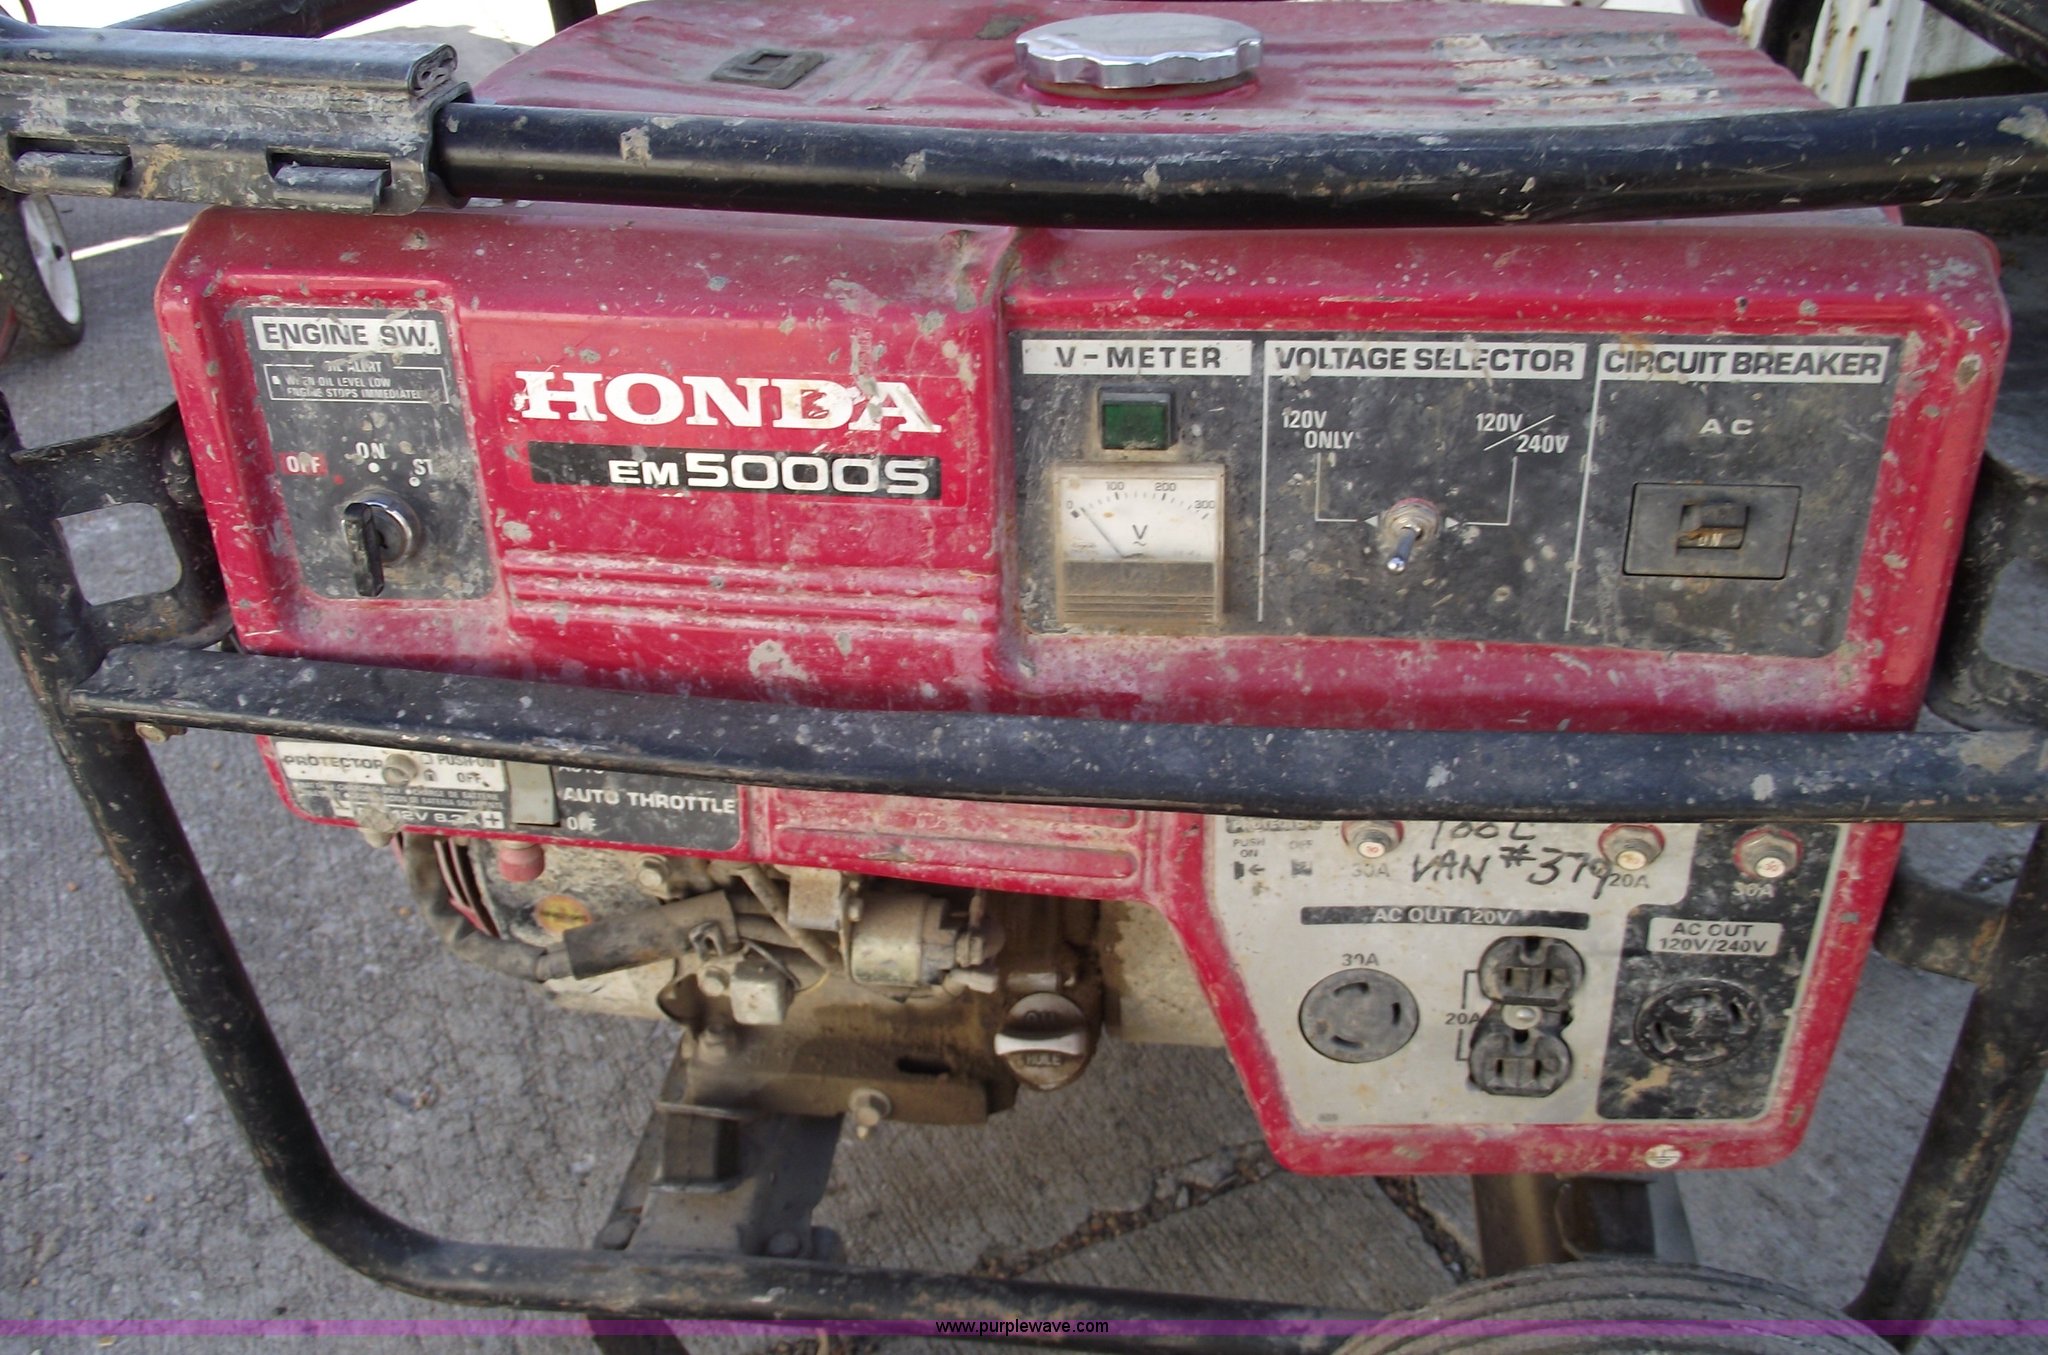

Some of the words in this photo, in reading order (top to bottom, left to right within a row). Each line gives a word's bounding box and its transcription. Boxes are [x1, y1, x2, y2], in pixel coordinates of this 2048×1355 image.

[262, 322, 369, 345] ENGINE
[380, 325, 435, 348] SW.
[1276, 347, 1406, 370] VOLTAGE
[1414, 348, 1575, 372] SELECTOR
[1604, 350, 1726, 374] CIRCUIT
[1731, 351, 1882, 376] BREAKER
[318, 377, 334, 387] OIL
[337, 378, 366, 387] LEVEL
[368, 378, 391, 388] LOW
[287, 387, 323, 398] ENGINE
[325, 388, 358, 398] STOPS
[513, 370, 942, 433] HONDA
[1282, 410, 1327, 429] 120V
[1304, 430, 1353, 449] ONLY
[355, 442, 386, 459] ON
[286, 454, 321, 473] OFF
[609, 452, 930, 495] EM5000S
[1105, 481, 1125, 492] 100
[1155, 482, 1177, 493] 200
[1066, 500, 1074, 510] 0
[1194, 500, 1216, 510] 300
[1132, 524, 1148, 541] V
[283, 755, 383, 770] PROTECTOR
[563, 787, 620, 805] AUTO
[627, 791, 736, 814] THROTTLE
[566, 816, 597, 832] OFF
[1233, 838, 1266, 848] PUSH
[1240, 849, 1259, 858] ON
[1412, 849, 1490, 885] VAN
[1608, 872, 1650, 889] 20A
[1731, 881, 1775, 898] 30A
[1373, 908, 1402, 923] AC
[1409, 908, 1455, 924] OUT
[1462, 909, 1513, 925] 120V
[1672, 923, 1701, 936] AC
[1708, 924, 1754, 938] OUT
[1659, 938, 1768, 953] 120V/240V
[1445, 1012, 1481, 1026] 20A
